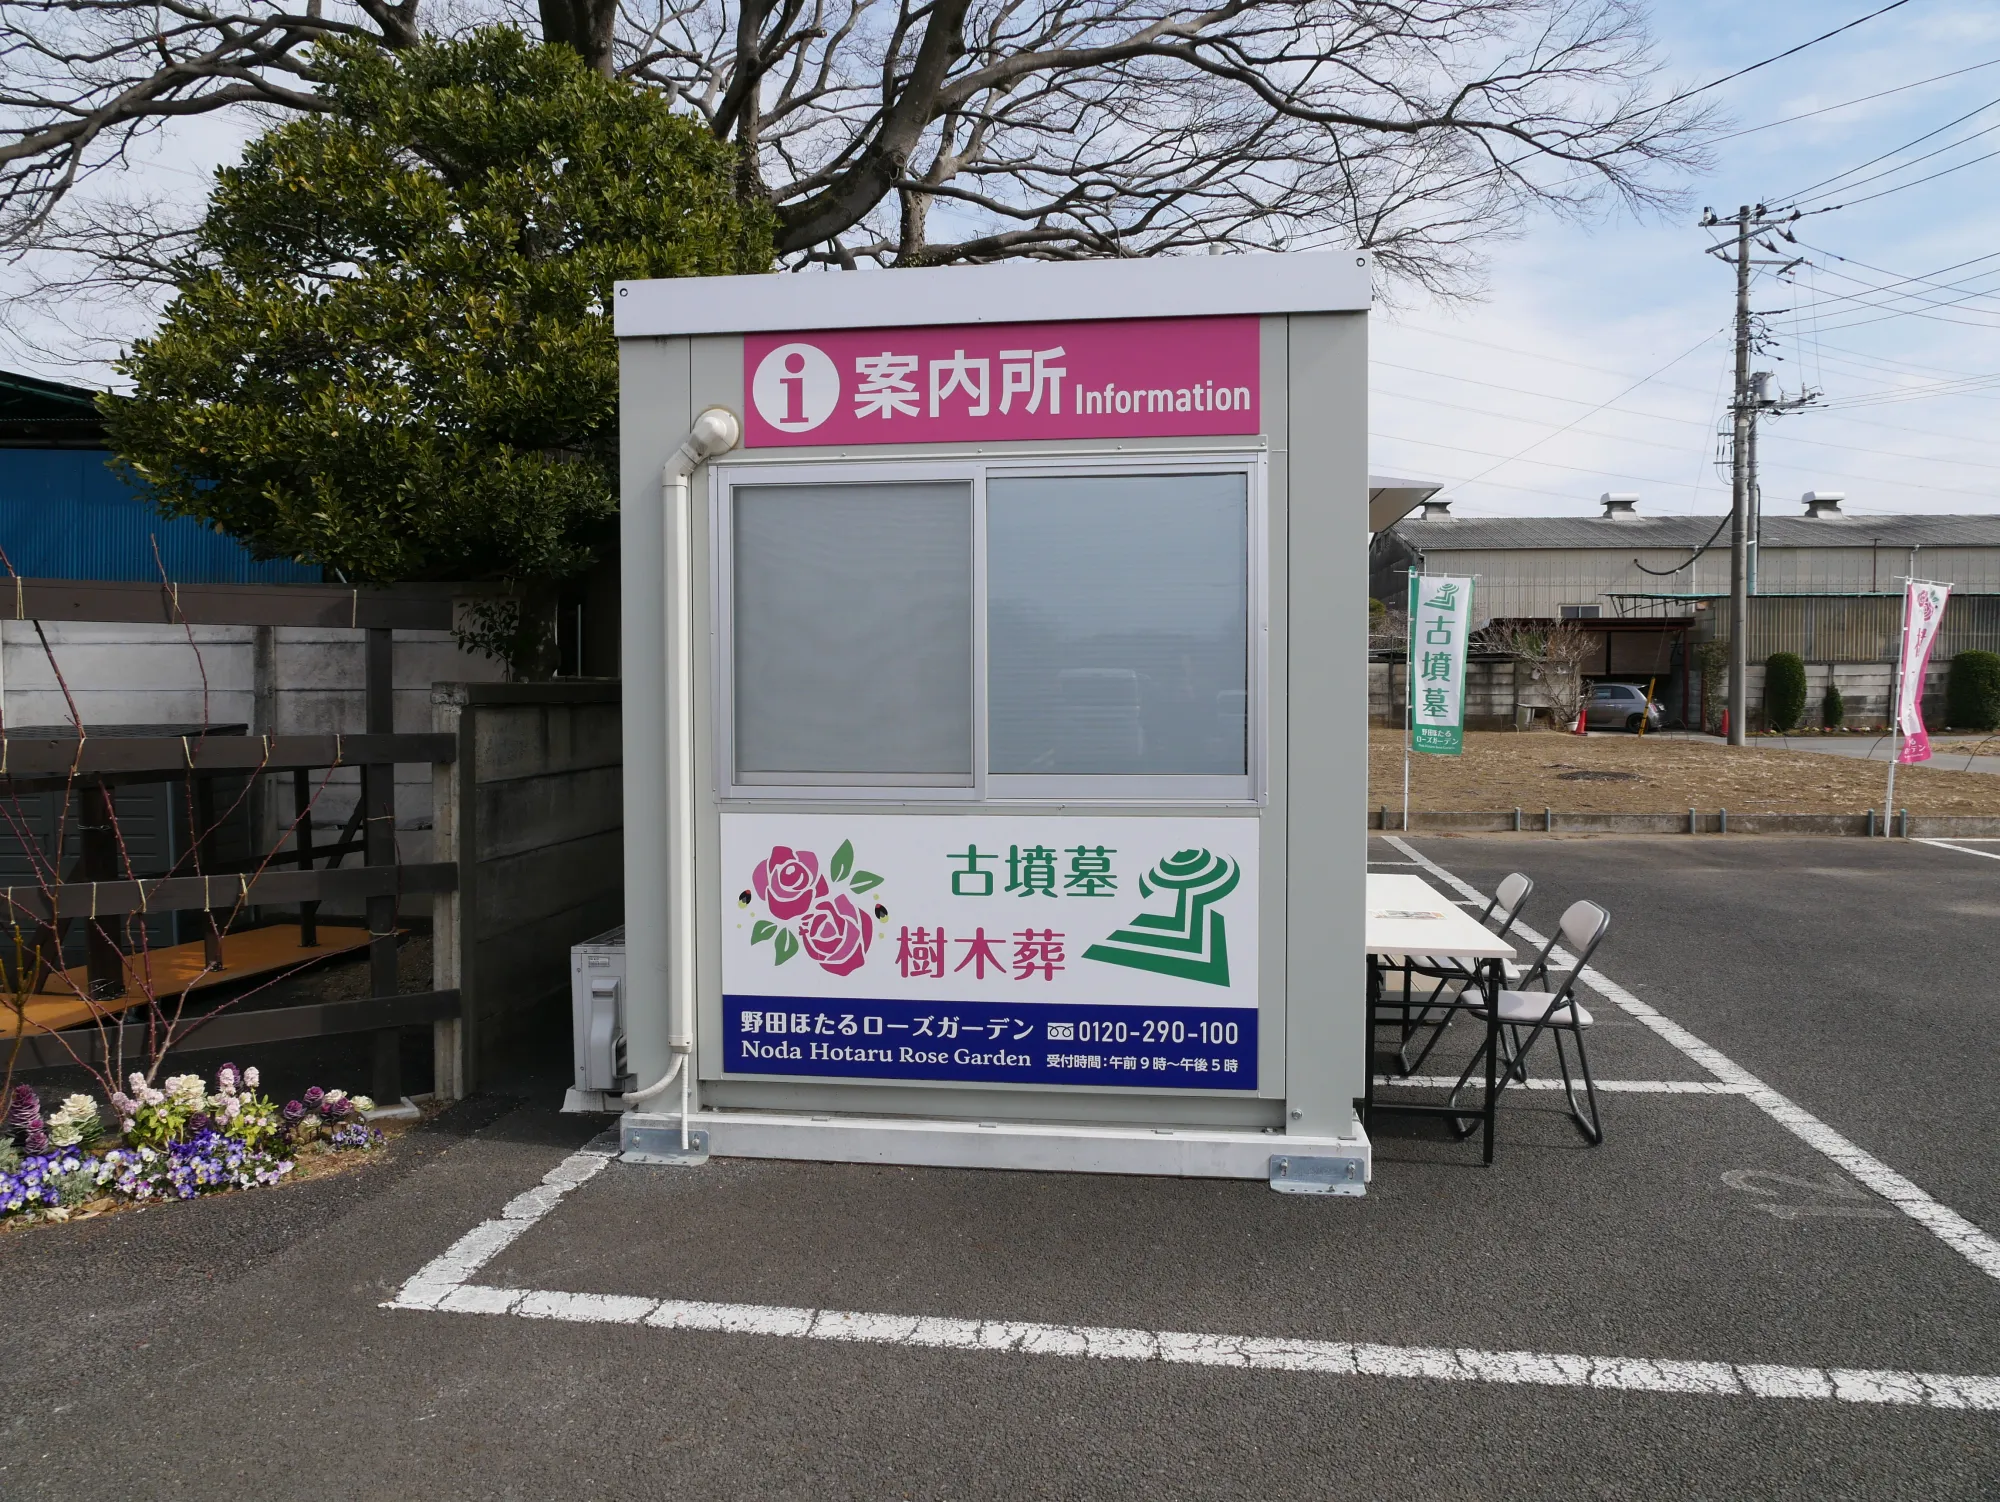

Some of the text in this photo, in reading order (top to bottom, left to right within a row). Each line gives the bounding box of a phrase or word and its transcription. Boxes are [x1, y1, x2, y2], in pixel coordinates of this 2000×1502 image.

[854, 345, 1067, 419] 案内所
[1076, 380, 1251, 415] Information
[1421, 615, 1455, 718] 古墳墓
[946, 843, 1118, 898] 古墳墓
[894, 926, 1066, 982] 樹木葬
[741, 1010, 1034, 1041] 野田ほたるローズガーデン
[1079, 1020, 1238, 1045] 0120-290-100
[741, 1040, 1032, 1067] Noda Hotaru Rose Garden
